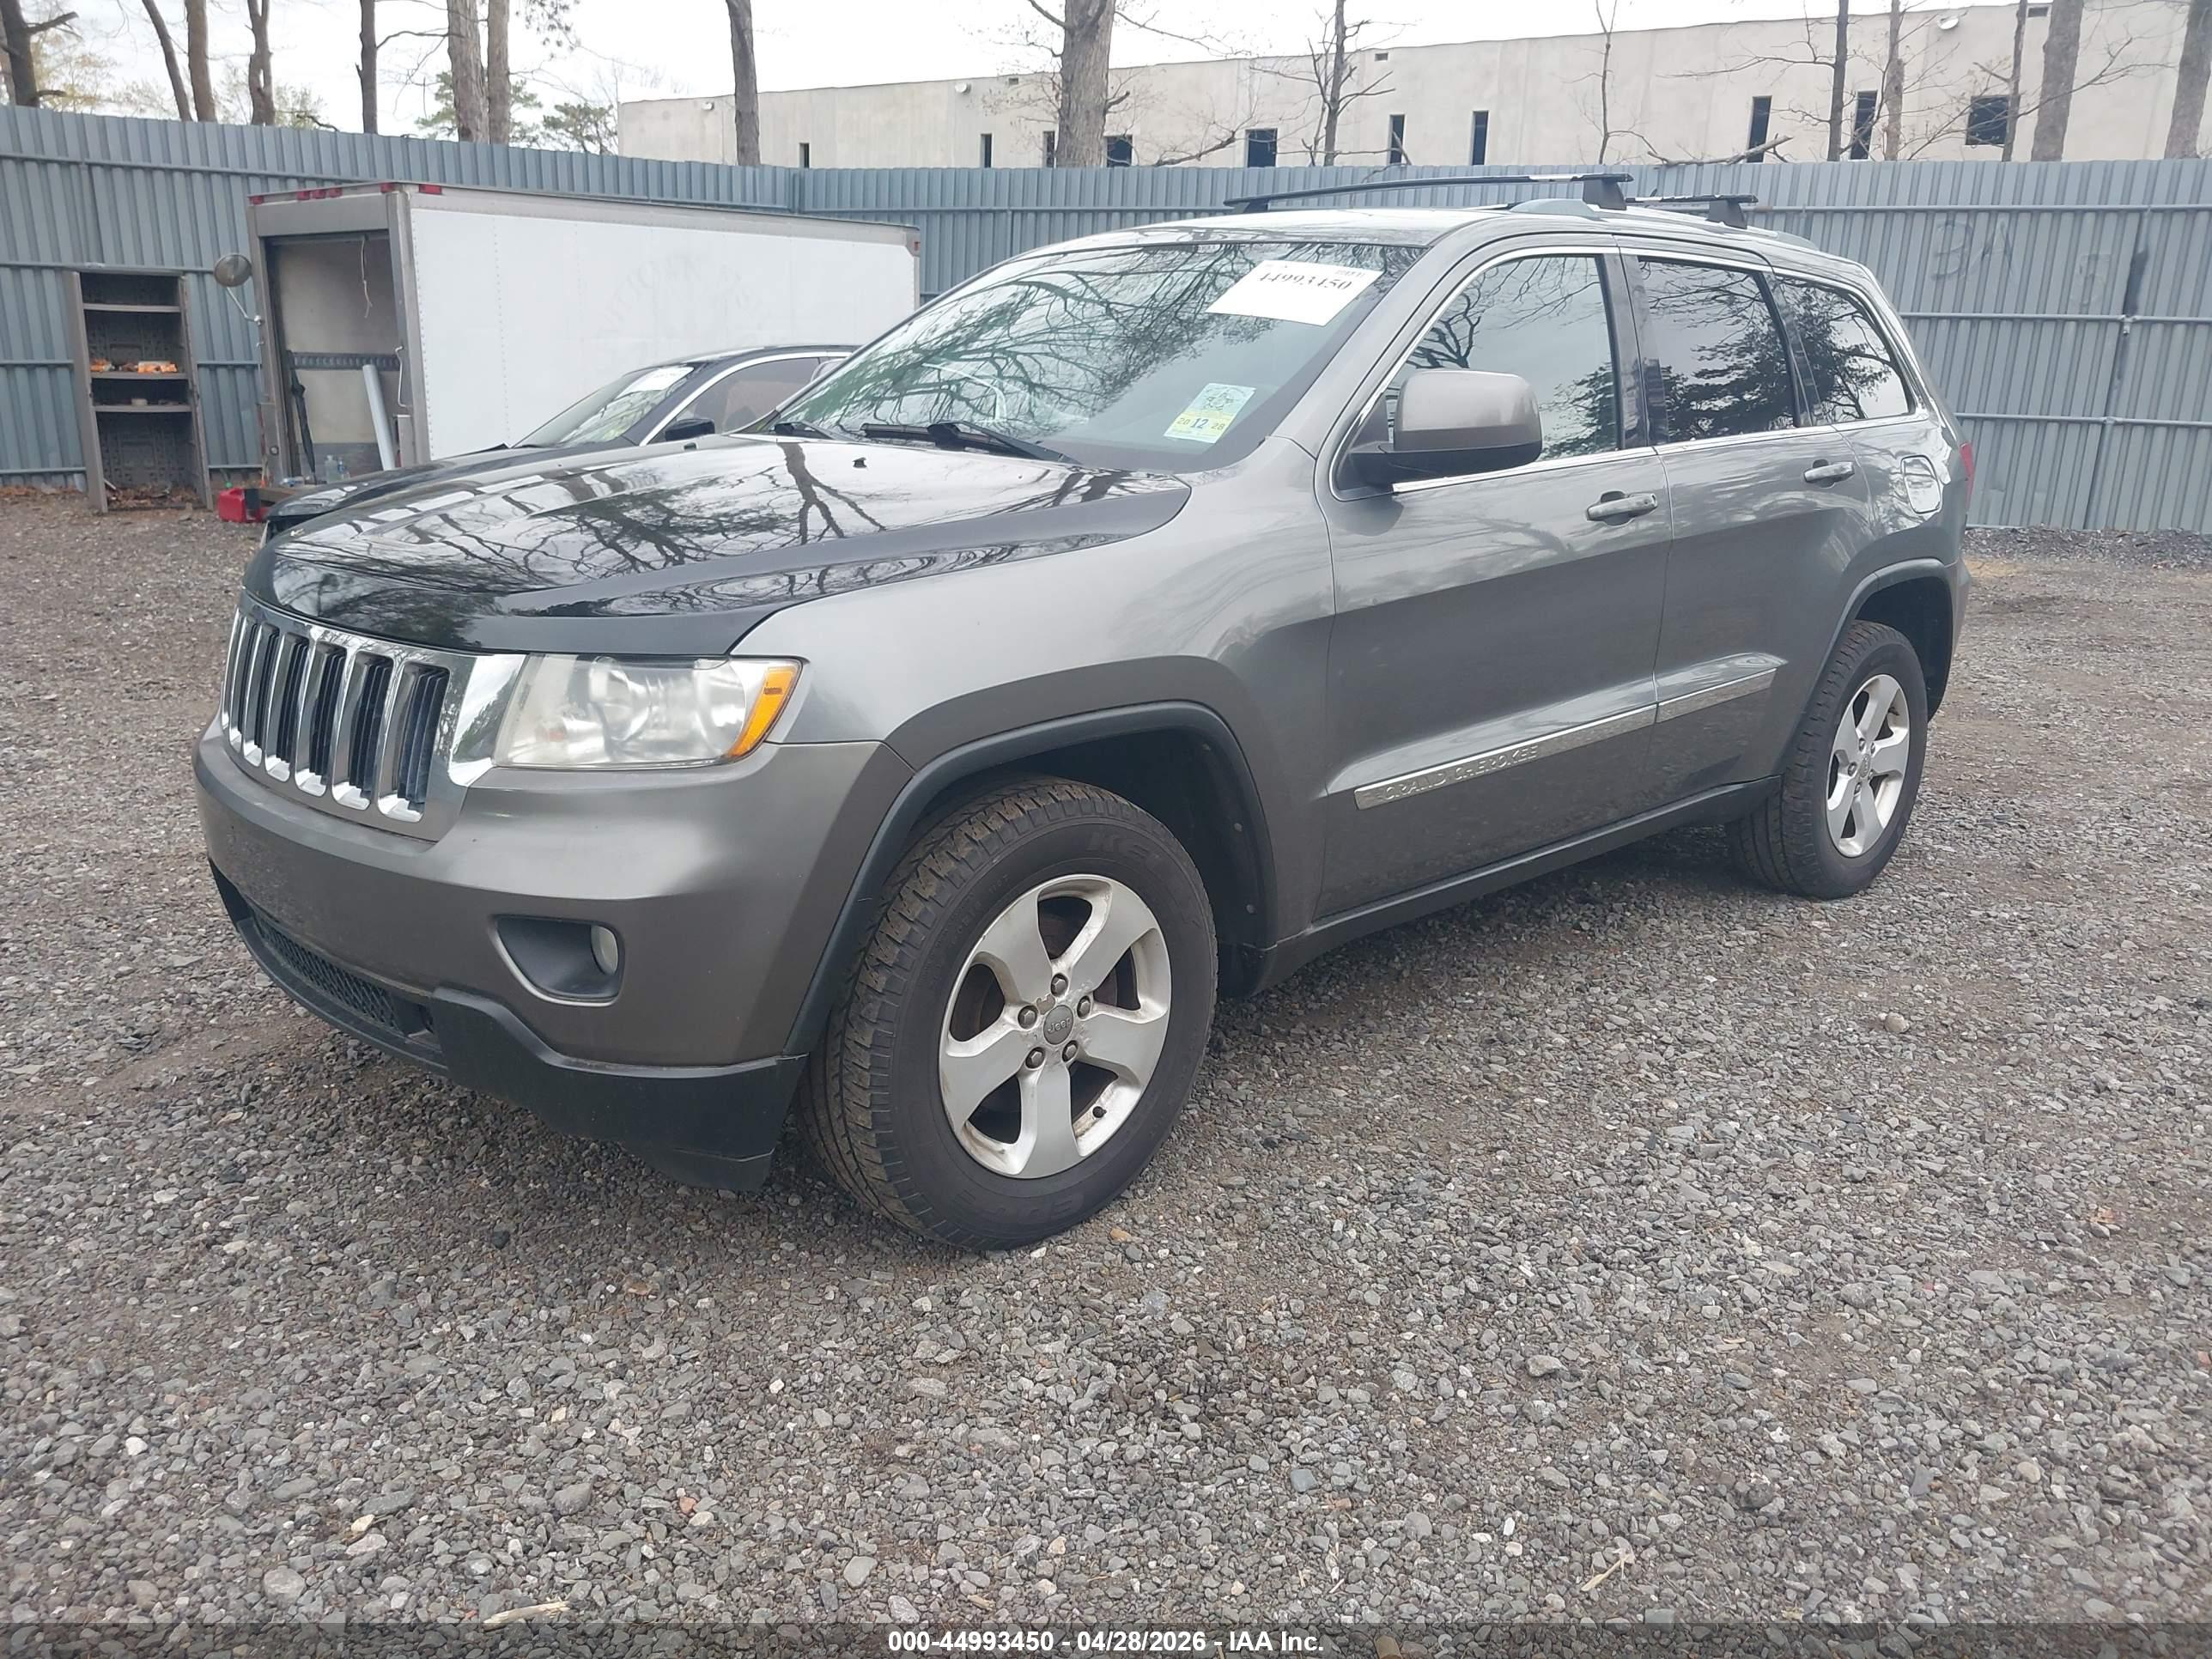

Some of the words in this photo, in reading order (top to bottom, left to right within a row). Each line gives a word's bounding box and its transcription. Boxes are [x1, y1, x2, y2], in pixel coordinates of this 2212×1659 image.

[1190, 417, 1210, 429] 12
[1385, 770, 1447, 800] GRAND
[1455, 744, 1539, 781] CHEROKEE
[1047, 1017, 1072, 1034] Jeep
